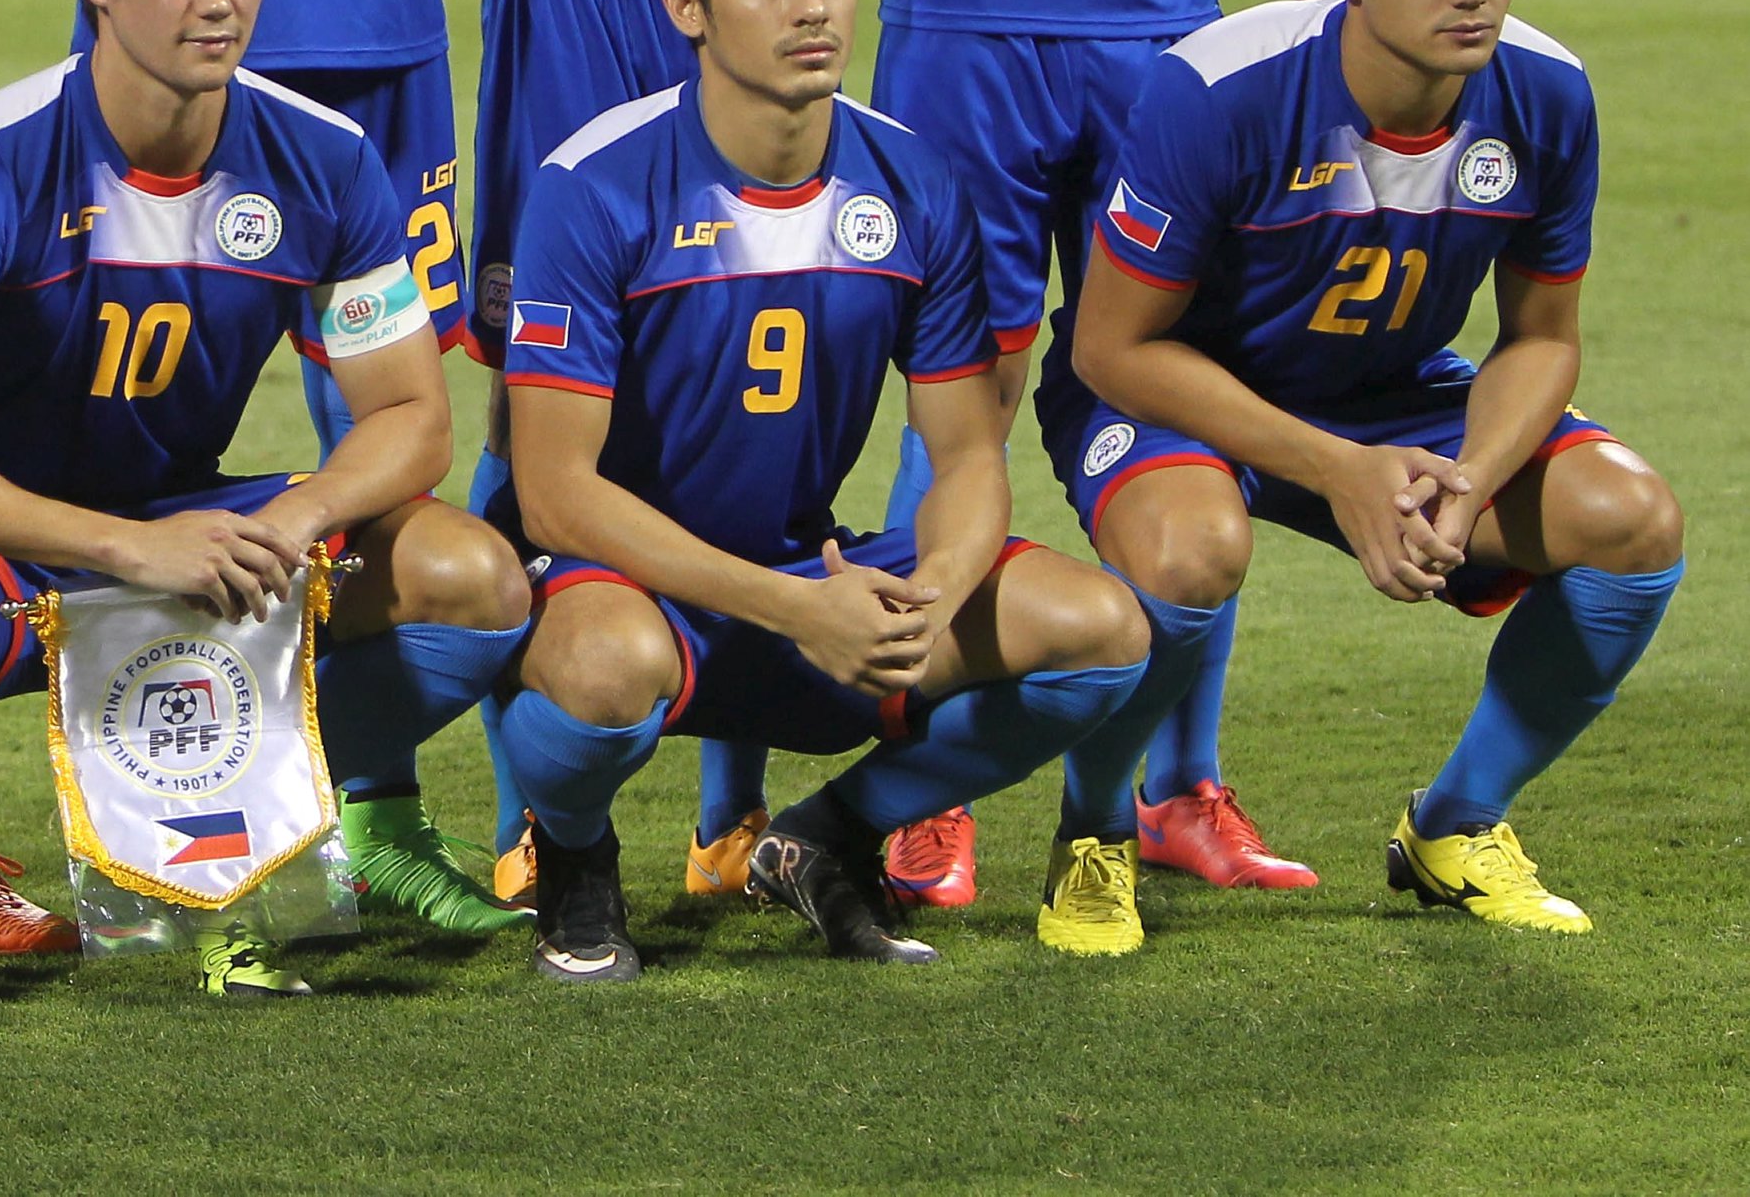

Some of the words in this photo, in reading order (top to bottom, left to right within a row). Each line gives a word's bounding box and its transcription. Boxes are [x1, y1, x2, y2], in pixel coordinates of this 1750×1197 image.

[1474, 175, 1503, 187] PFF
[233, 230, 267, 245] PFF
[856, 232, 885, 244] PFF
[1308, 246, 1427, 335] 21
[90, 301, 192, 400] 10
[743, 307, 806, 414] 9
[125, 642, 216, 678] FOOTBALL
[103, 680, 150, 781] PHILIPPINE
[220, 657, 251, 769] FEDERATION
[150, 723, 222, 758] PFF
[173, 775, 208, 791] 1907
